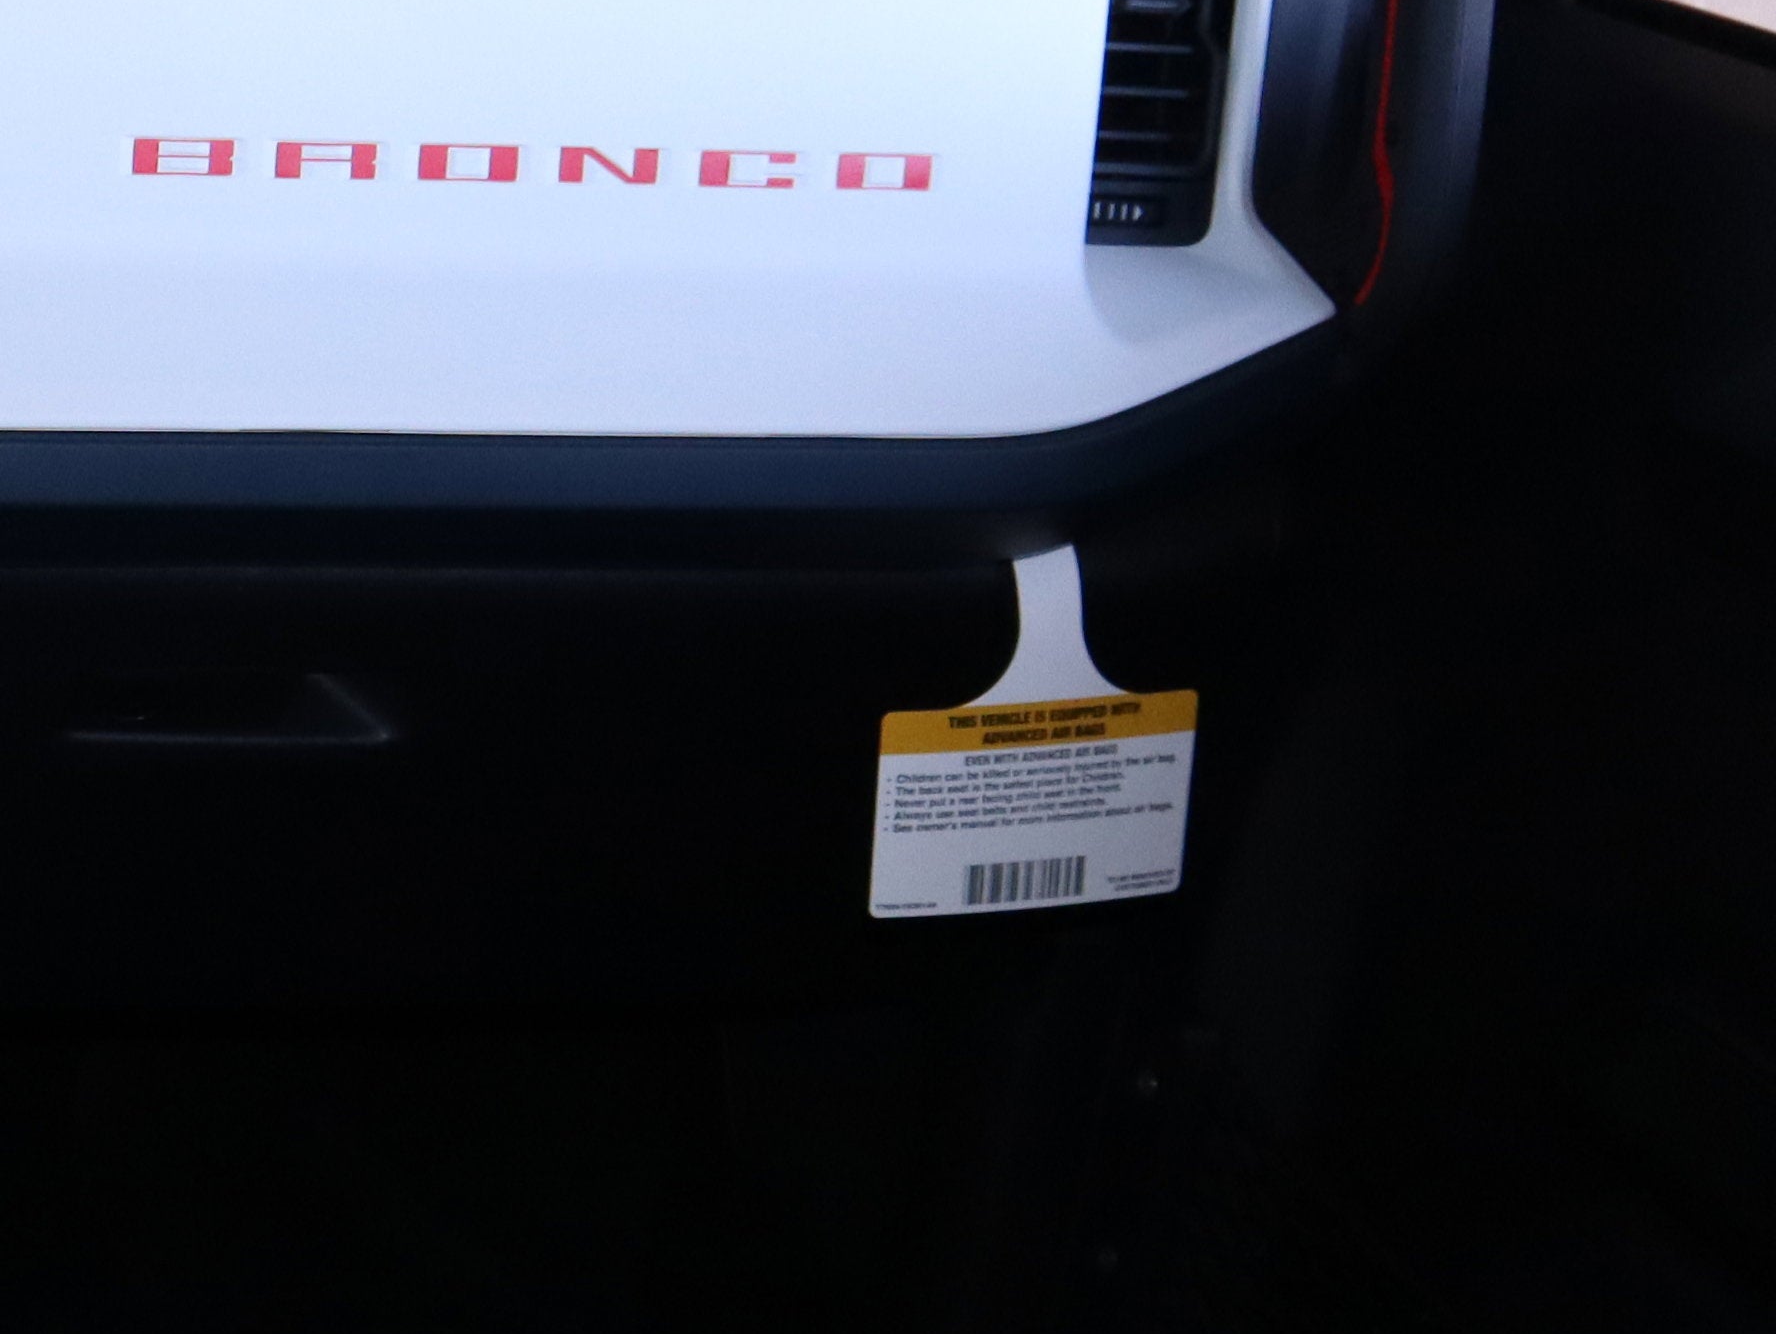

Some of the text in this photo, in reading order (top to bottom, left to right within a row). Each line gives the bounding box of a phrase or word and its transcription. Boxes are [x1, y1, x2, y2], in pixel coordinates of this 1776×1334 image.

[132, 136, 933, 191] BRONCO
[949, 715, 977, 729] THIS
[980, 711, 1031, 726] VEHICLE
[1050, 705, 1107, 721] EQUIPPED
[983, 727, 1047, 744] ADVANCED
[1075, 723, 1105, 737] BAGS
[965, 755, 990, 766] EVEN
[994, 753, 1018, 764] WITH
[1022, 749, 1071, 762] ADVANCED
[897, 774, 941, 783] Children
[967, 772, 979, 780] be
[983, 769, 1010, 779] killed
[1126, 757, 1139, 765] the
[896, 787, 915, 795] The
[918, 785, 943, 794] back
[948, 785, 969, 793] seat
[985, 782, 999, 790] the
[895, 799, 925, 807] Never
[982, 794, 1013, 804] facing
[894, 812, 932, 820] Always
[982, 807, 1007, 815] belts
[893, 824, 912, 833] See
[916, 822, 957, 831] owner's
[960, 820, 996, 829] manual
